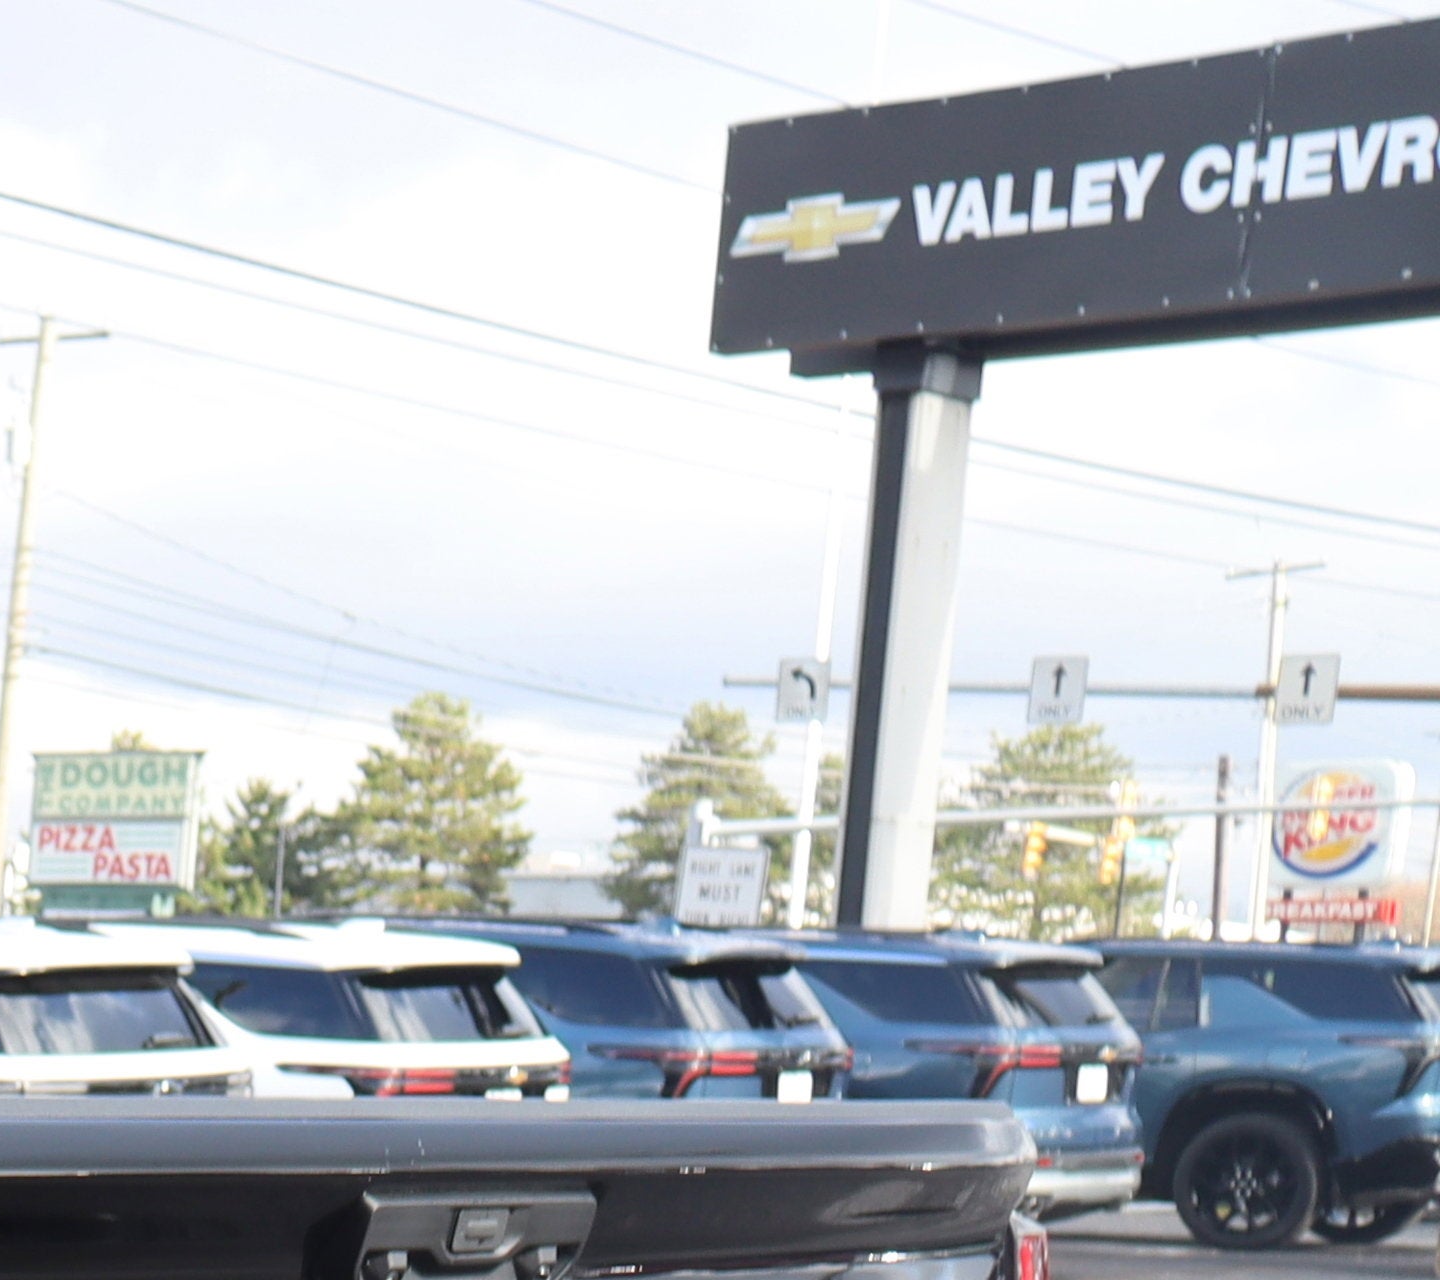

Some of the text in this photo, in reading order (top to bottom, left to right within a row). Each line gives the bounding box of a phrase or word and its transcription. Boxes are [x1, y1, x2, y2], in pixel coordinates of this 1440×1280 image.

[913, 114, 1440, 247] VALLEY CHEVR
[59, 759, 188, 791] DOUGH
[58, 794, 185, 816] COMPANY
[37, 825, 116, 853] PIZZA
[91, 851, 172, 882] PASTA
